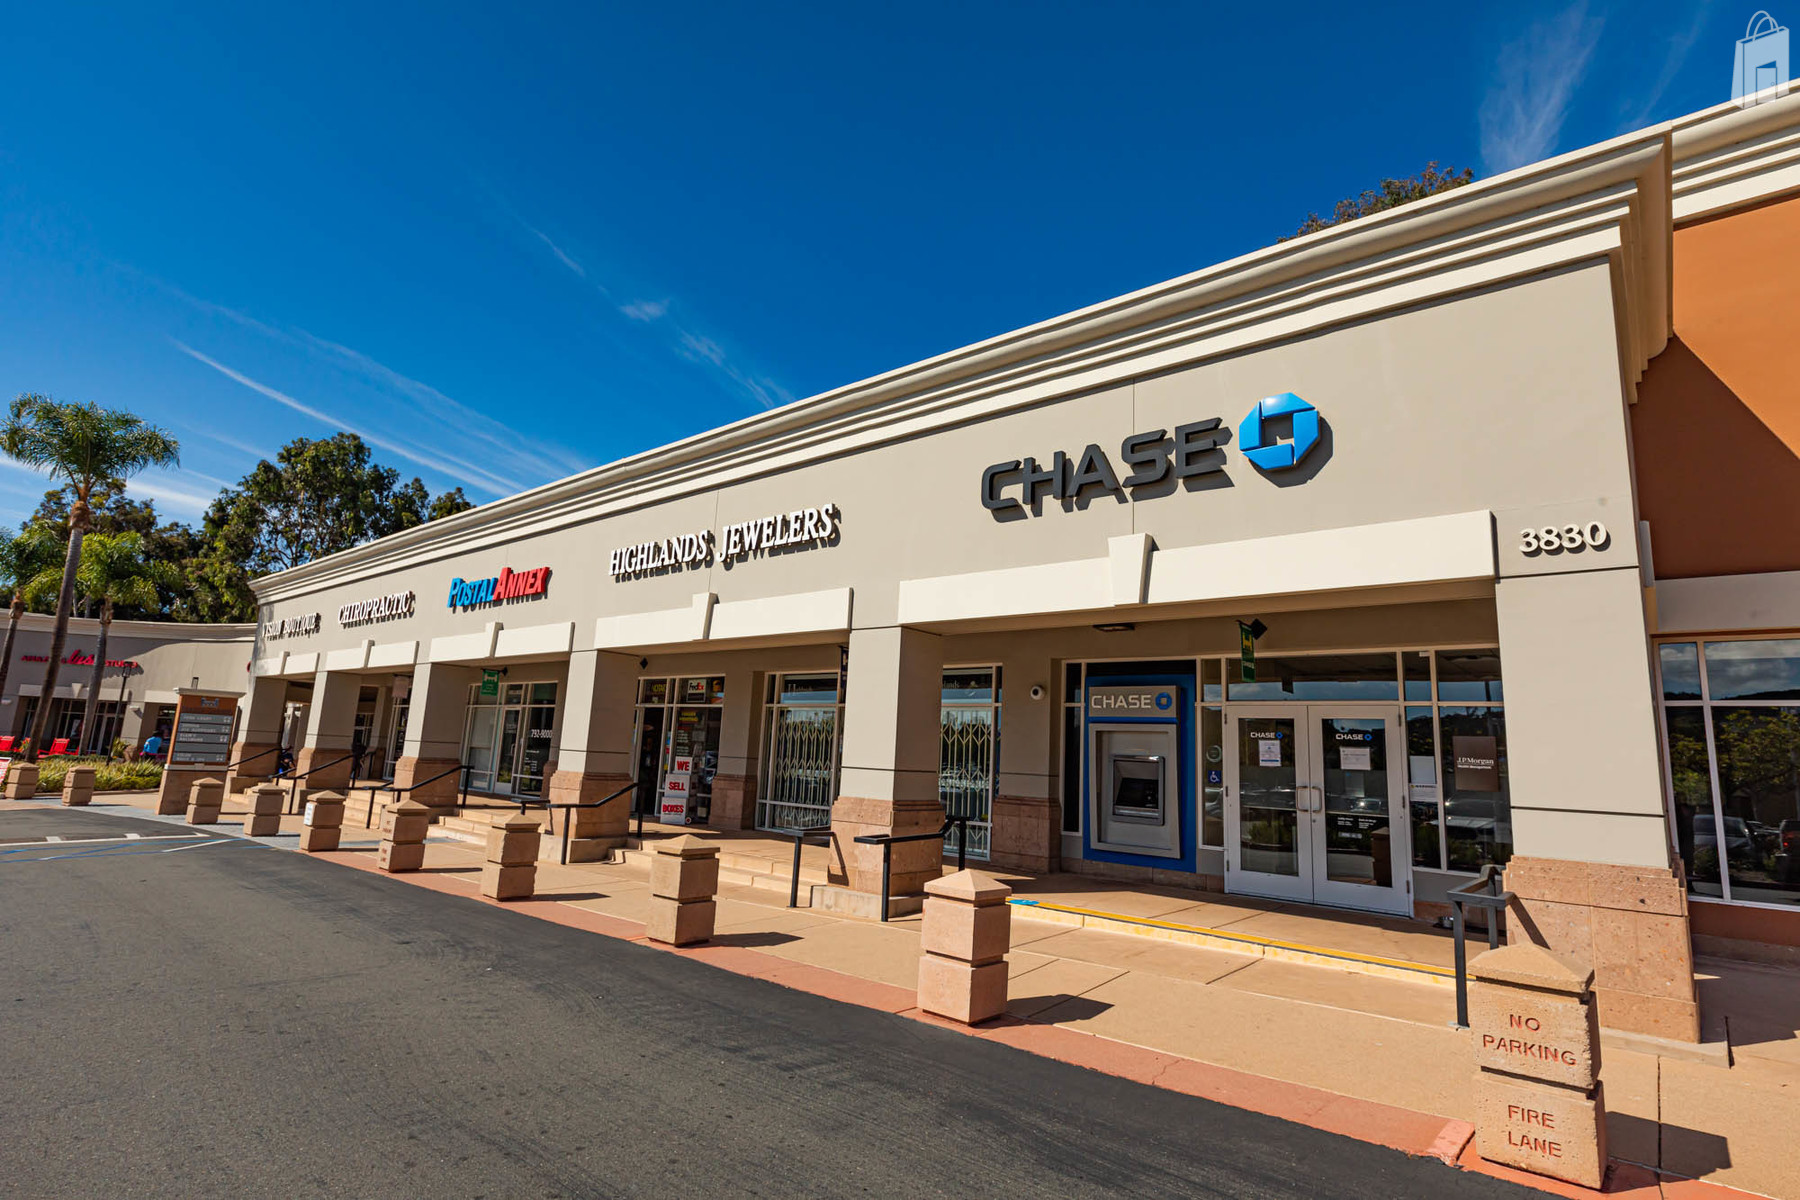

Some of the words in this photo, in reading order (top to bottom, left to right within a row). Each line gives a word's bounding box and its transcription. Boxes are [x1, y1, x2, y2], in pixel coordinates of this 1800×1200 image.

[981, 417, 1223, 511] CHASE
[609, 530, 710, 577] HIGHLANDS
[718, 503, 836, 562] JEWELERS
[1519, 521, 1608, 553] 3830
[338, 591, 413, 624] CHIROPRACTIC
[1091, 695, 1152, 709] CHASE
[677, 760, 690, 771] WE
[668, 782, 686, 791] SELL
[661, 804, 685, 813] BOXES
[1509, 1013, 1541, 1031] NO
[1482, 1034, 1577, 1066] PARKING
[1508, 1104, 1556, 1129] FIRE
[1508, 1130, 1563, 1159] LANE
